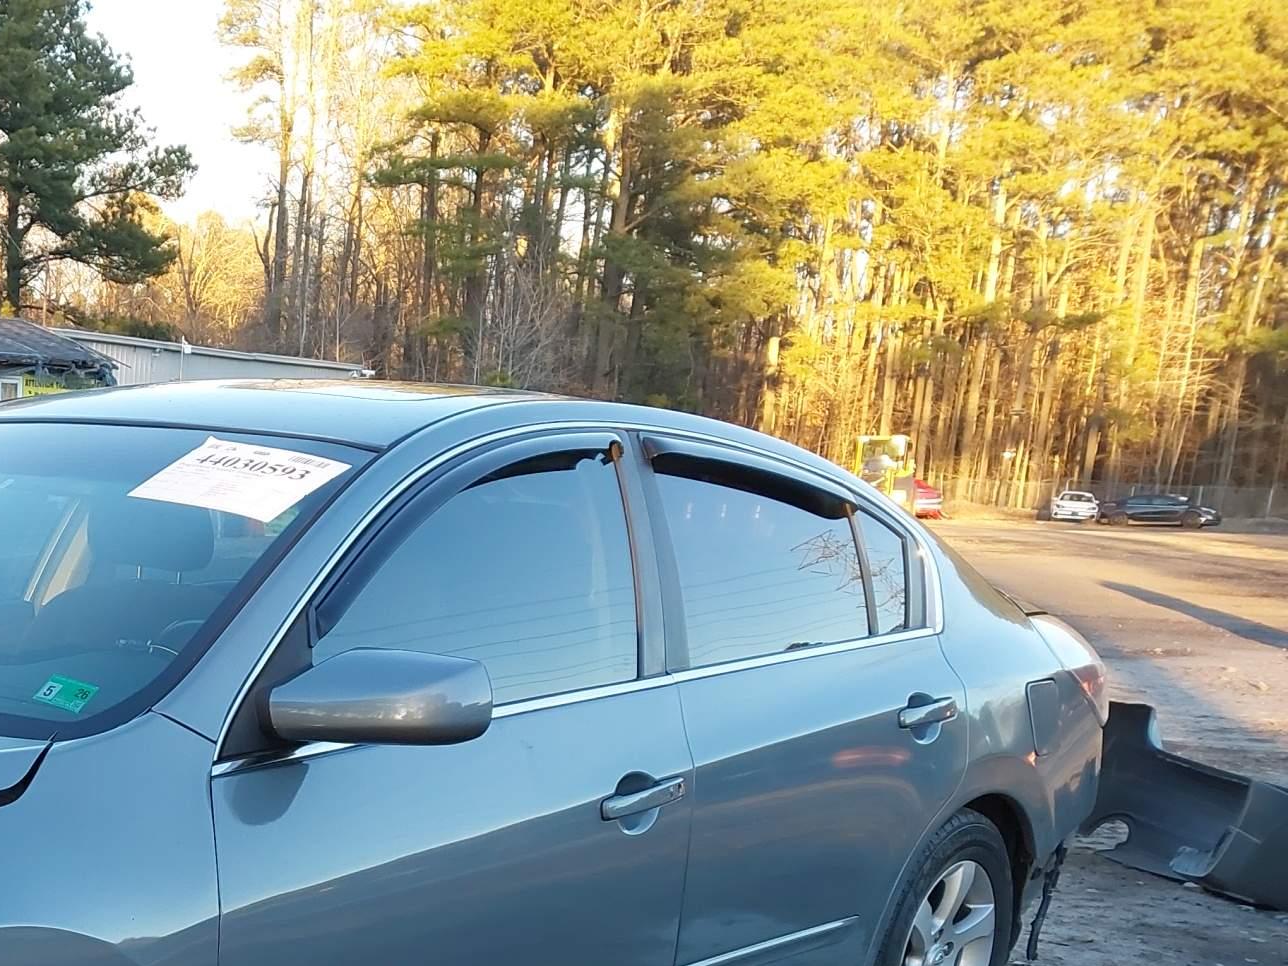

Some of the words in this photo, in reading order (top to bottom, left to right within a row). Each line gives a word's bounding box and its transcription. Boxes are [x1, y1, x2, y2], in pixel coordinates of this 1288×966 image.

[196, 453, 312, 480] 44030593
[43, 686, 57, 697] 5
[75, 688, 91, 700] 26
